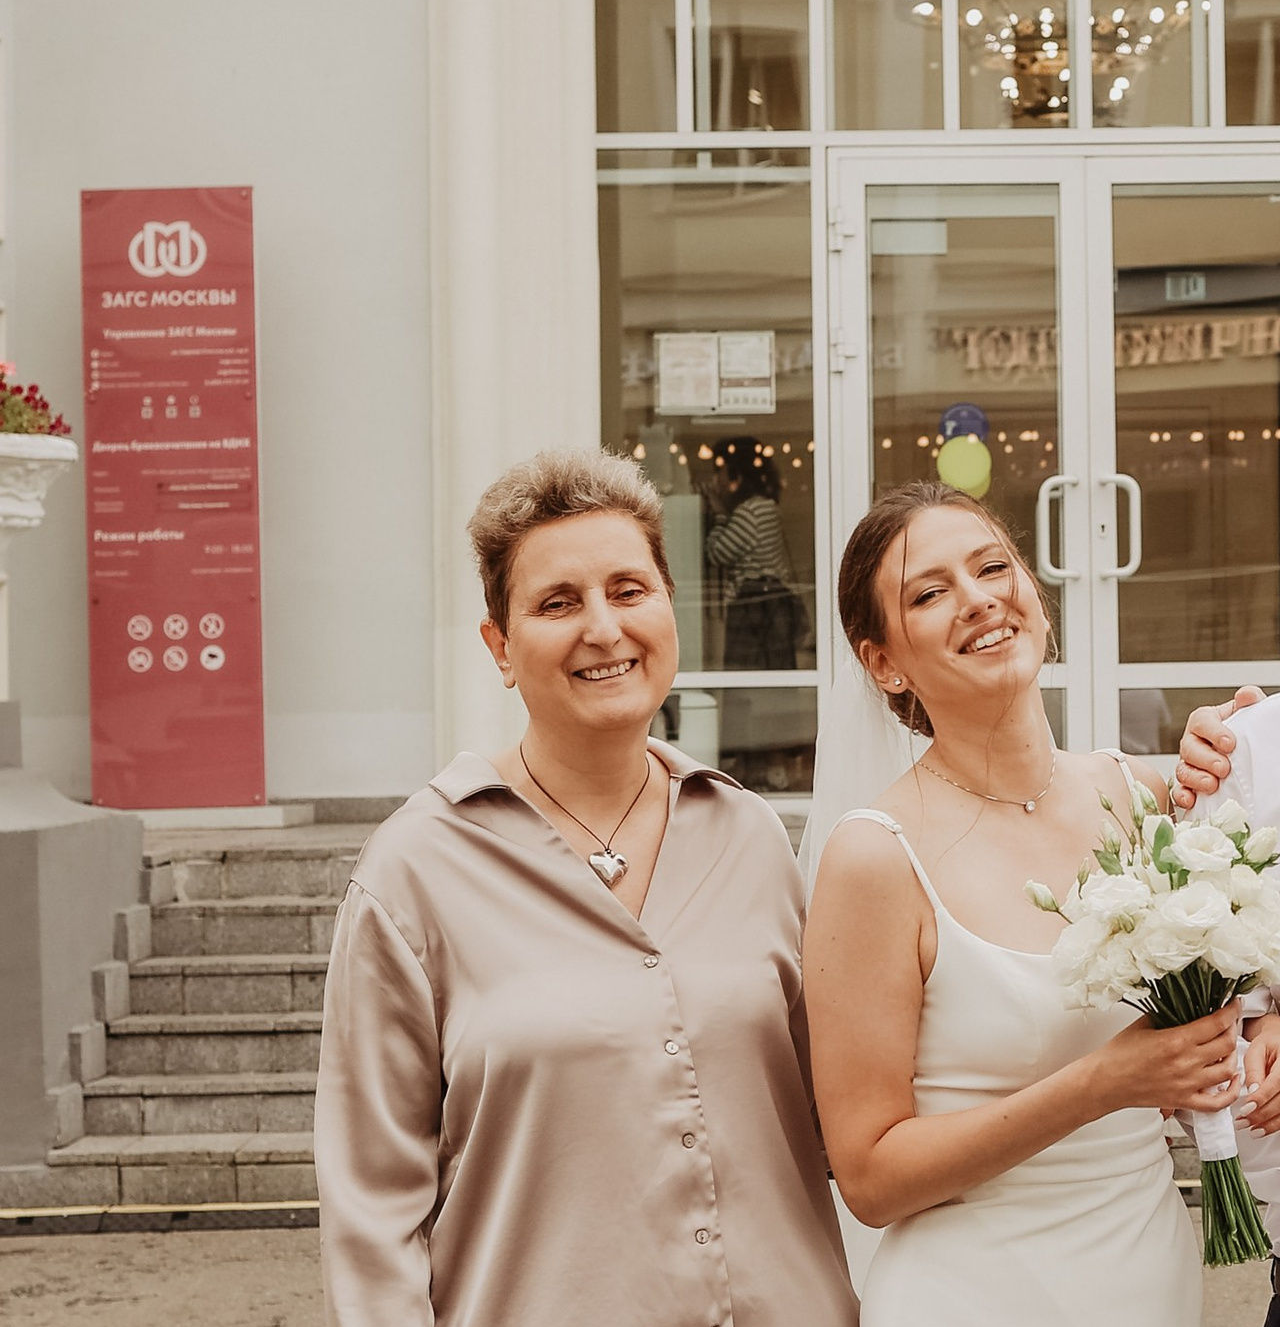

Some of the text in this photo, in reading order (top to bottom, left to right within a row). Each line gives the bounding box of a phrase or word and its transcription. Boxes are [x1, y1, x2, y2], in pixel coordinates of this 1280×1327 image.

[102, 289, 236, 308] ЗАГС МОСКВЫ
[168, 326, 194, 338] ЗАГС
[195, 326, 237, 338] Москвы
[94, 528, 184, 543] Режим работы
